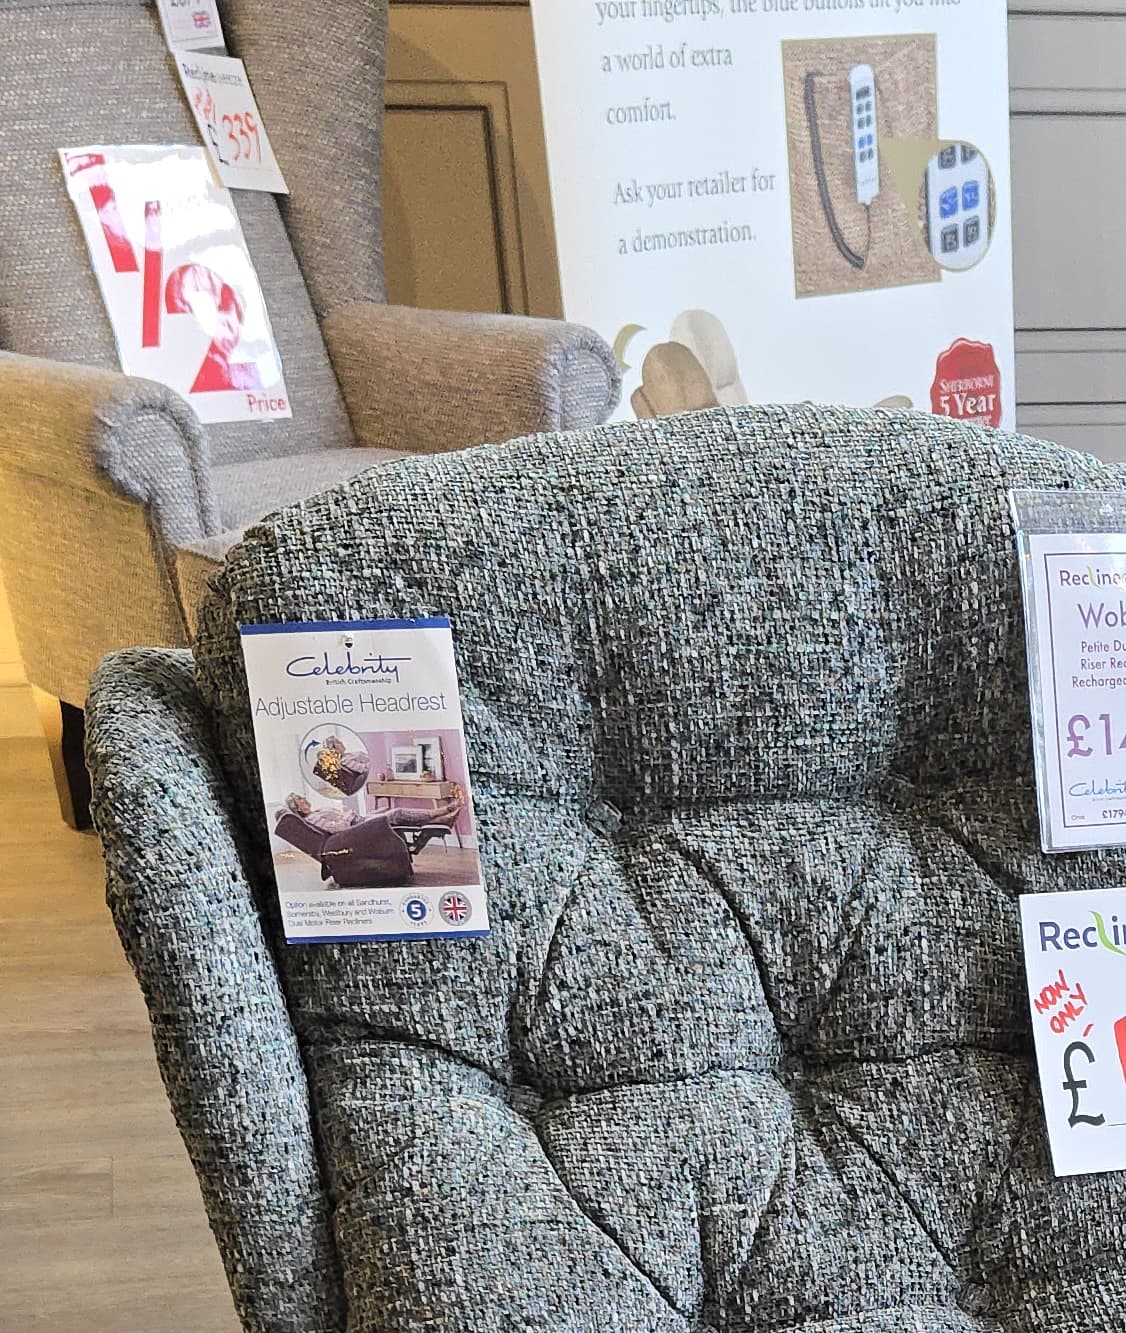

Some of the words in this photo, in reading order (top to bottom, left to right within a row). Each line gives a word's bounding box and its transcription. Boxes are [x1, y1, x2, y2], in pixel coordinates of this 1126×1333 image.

[594, 0, 637, 26] your
[602, 55, 611, 72] a
[615, 44, 664, 72] world
[670, 42, 688, 68] of
[692, 48, 733, 67] extra
[607, 97, 676, 124] comfort.
[613, 179, 643, 205] Ask
[647, 182, 683, 208] your
[688, 171, 746, 198] retailer
[751, 168, 776, 191] for
[619, 238, 627, 255] a
[632, 221, 756, 253] demonstration.
[247, 393, 287, 413] Price
[940, 395, 951, 416] 5
[952, 393, 996, 415] Year
[1081, 640, 1109, 653] Petite
[286, 652, 411, 682] Celebrity
[1081, 658, 1106, 670] Riser
[256, 694, 353, 721] Adjustable
[359, 691, 447, 713] Headrest
[411, 903, 422, 918] 5
[1034, 969, 1070, 1014] NOW
[1050, 982, 1088, 1033] ONLY
